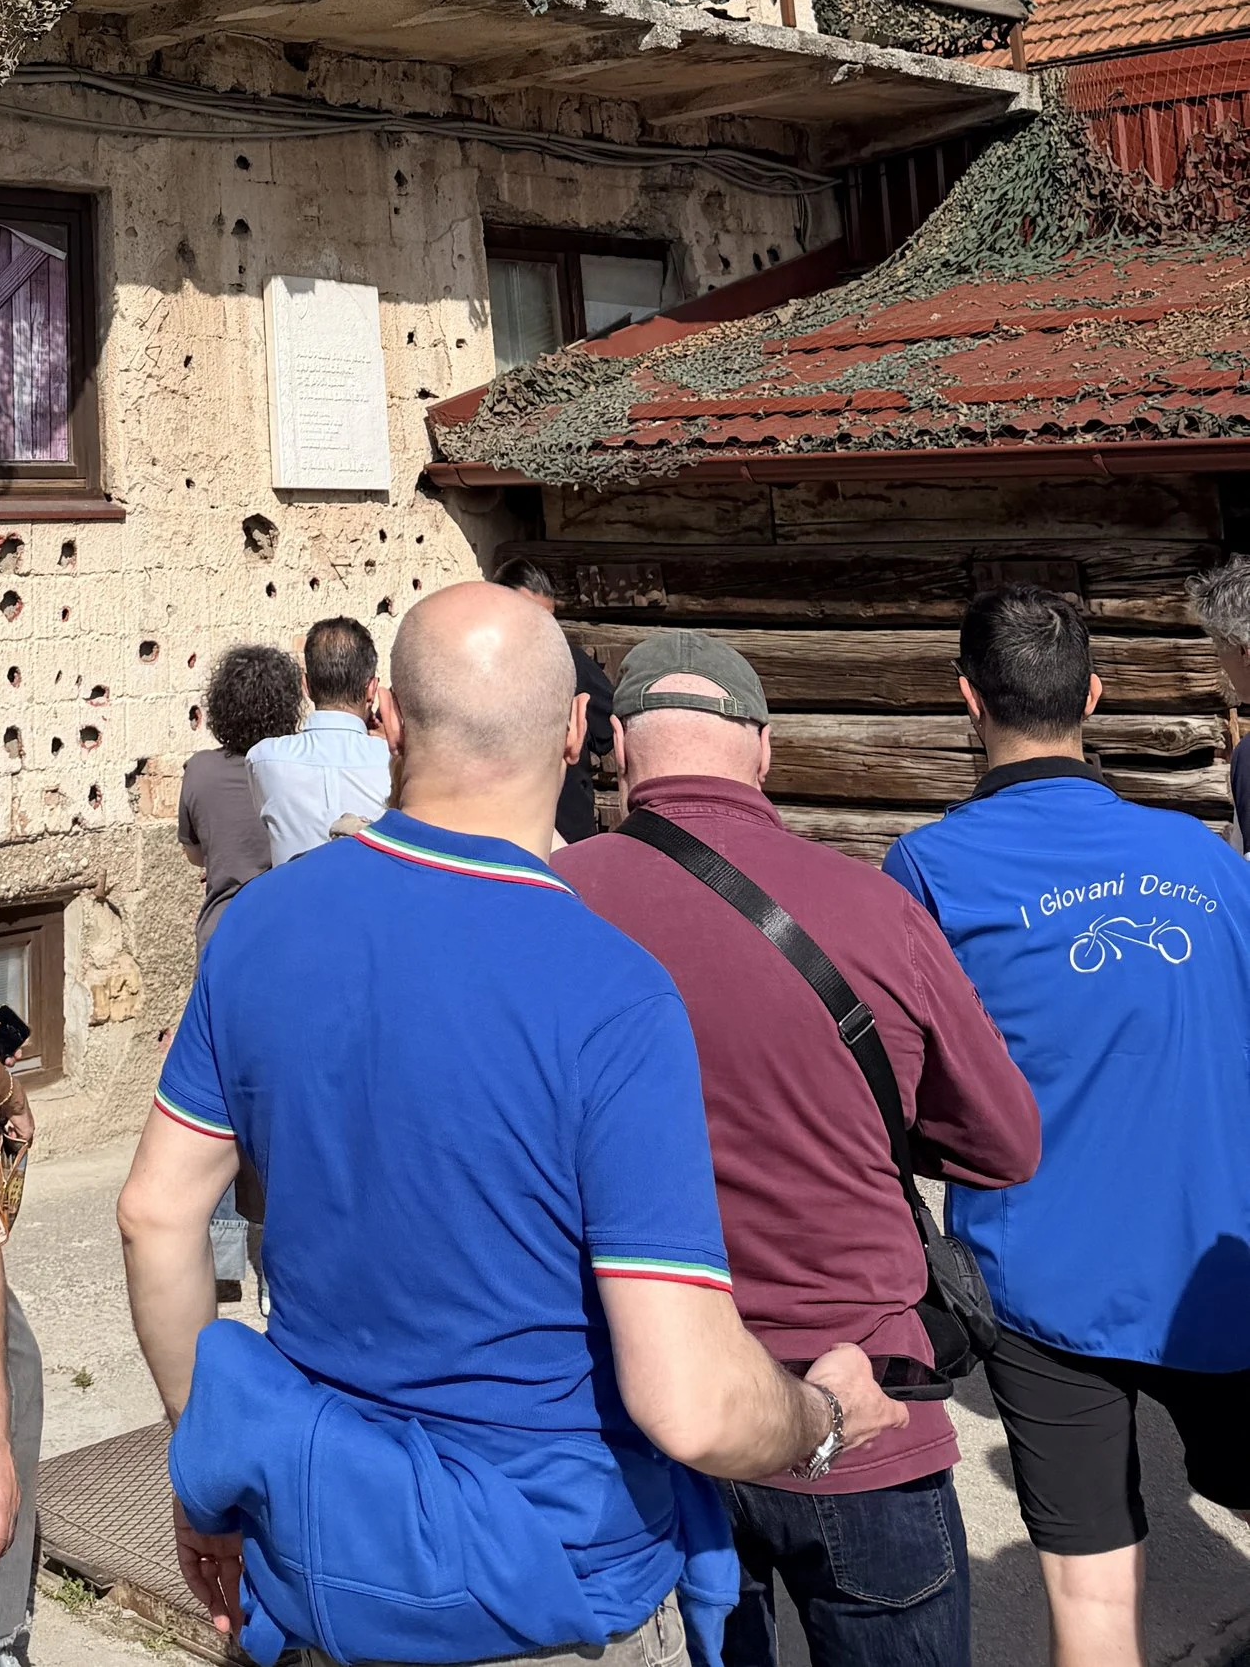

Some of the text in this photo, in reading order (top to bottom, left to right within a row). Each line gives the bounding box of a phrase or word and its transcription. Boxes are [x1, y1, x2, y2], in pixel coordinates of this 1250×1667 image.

[1020, 871, 1218, 929] I Giovani Dentro
